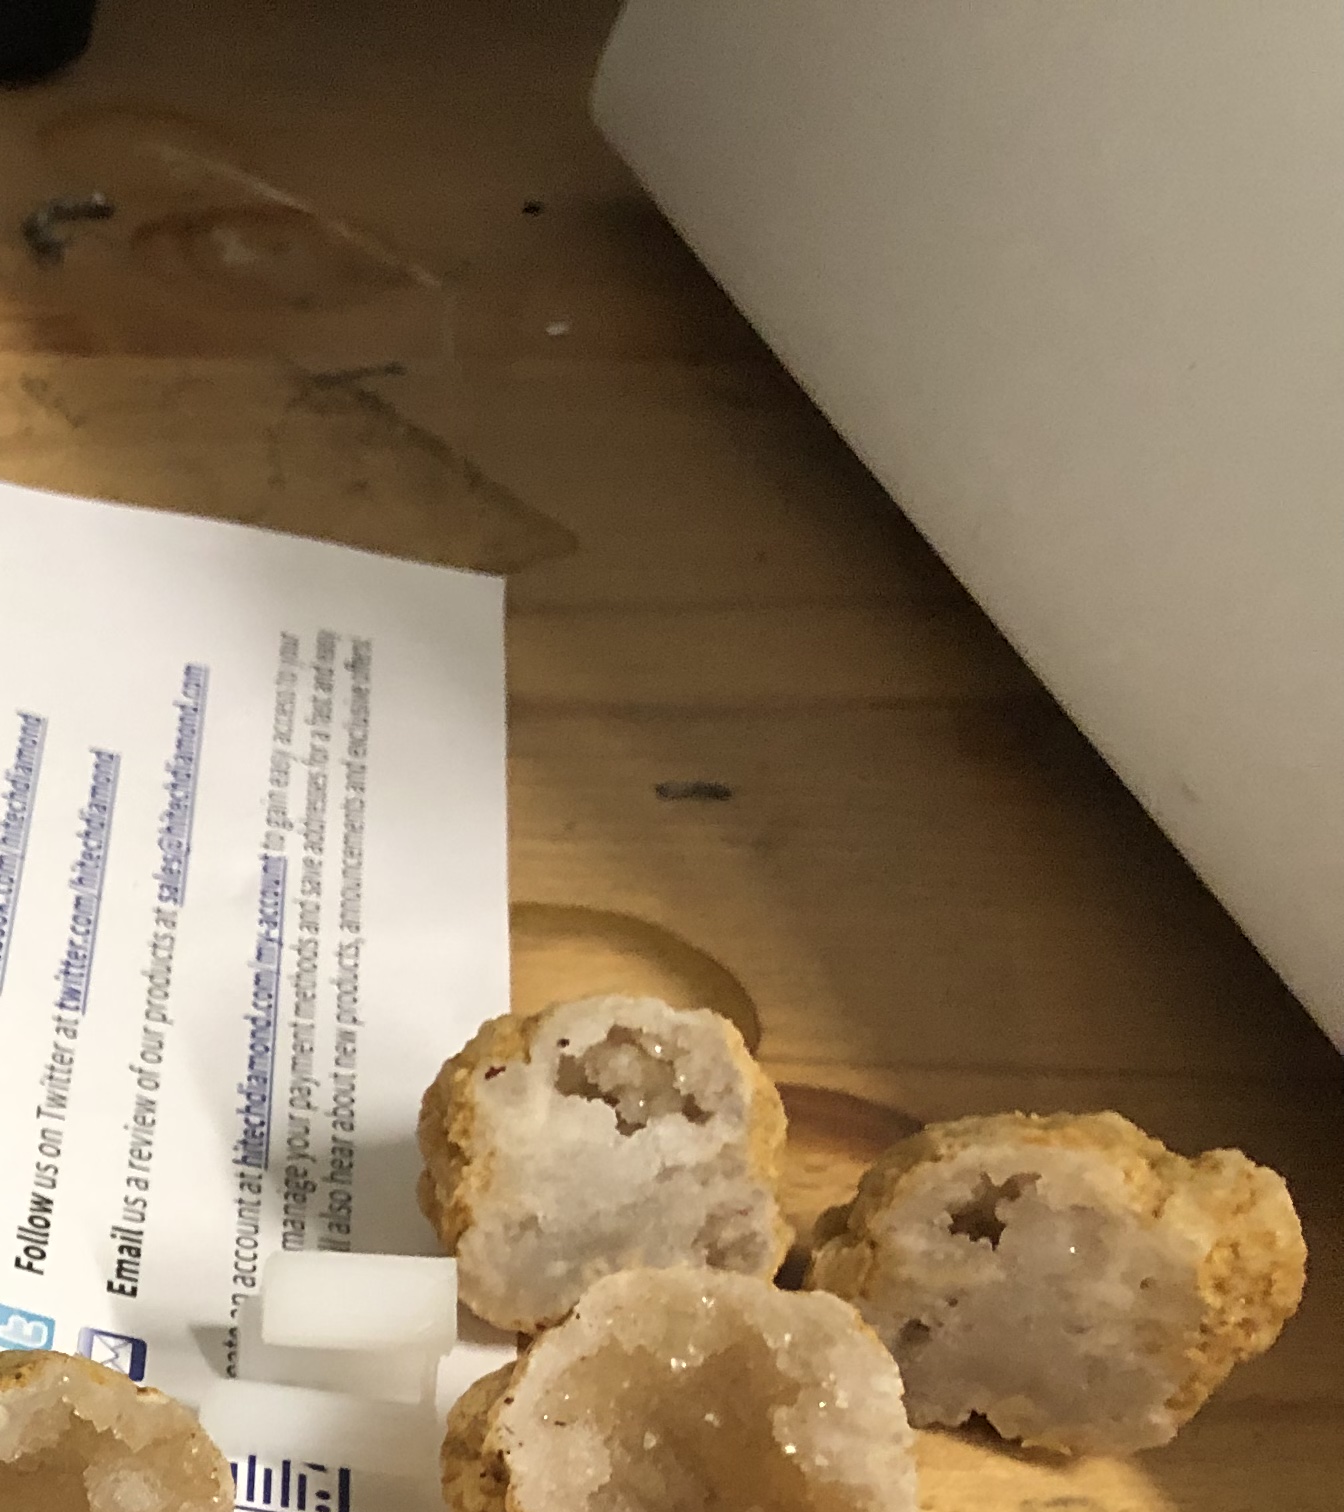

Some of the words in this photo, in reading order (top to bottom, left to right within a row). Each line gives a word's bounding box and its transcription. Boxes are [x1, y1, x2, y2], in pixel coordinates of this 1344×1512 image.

[274, 670, 297, 686] to
[258, 830, 285, 851] to
[300, 855, 323, 896] save
[149, 906, 177, 930] at
[291, 900, 320, 934] and
[141, 931, 176, 1025] products
[288, 936, 319, 1017] methods
[53, 1015, 79, 1040] at
[138, 1026, 165, 1064] our
[286, 1022, 320, 1111] payment
[333, 1030, 356, 1069] new
[35, 1040, 77, 1123] Twitter
[128, 1064, 160, 1091] of
[325, 1072, 356, 1130] about
[36, 1126, 64, 1159] on
[122, 1094, 158, 1172] review
[285, 1112, 318, 1162] your
[32, 1160, 59, 1189] us
[323, 1136, 353, 1184] hear
[124, 1175, 149, 1191] a
[233, 1171, 263, 1195] at
[121, 1195, 148, 1223] us
[281, 1164, 316, 1251] manage
[318, 1188, 352, 1234] also
[14, 1191, 55, 1275] Follow
[233, 1197, 262, 1289] account
[105, 1225, 146, 1298] Email
